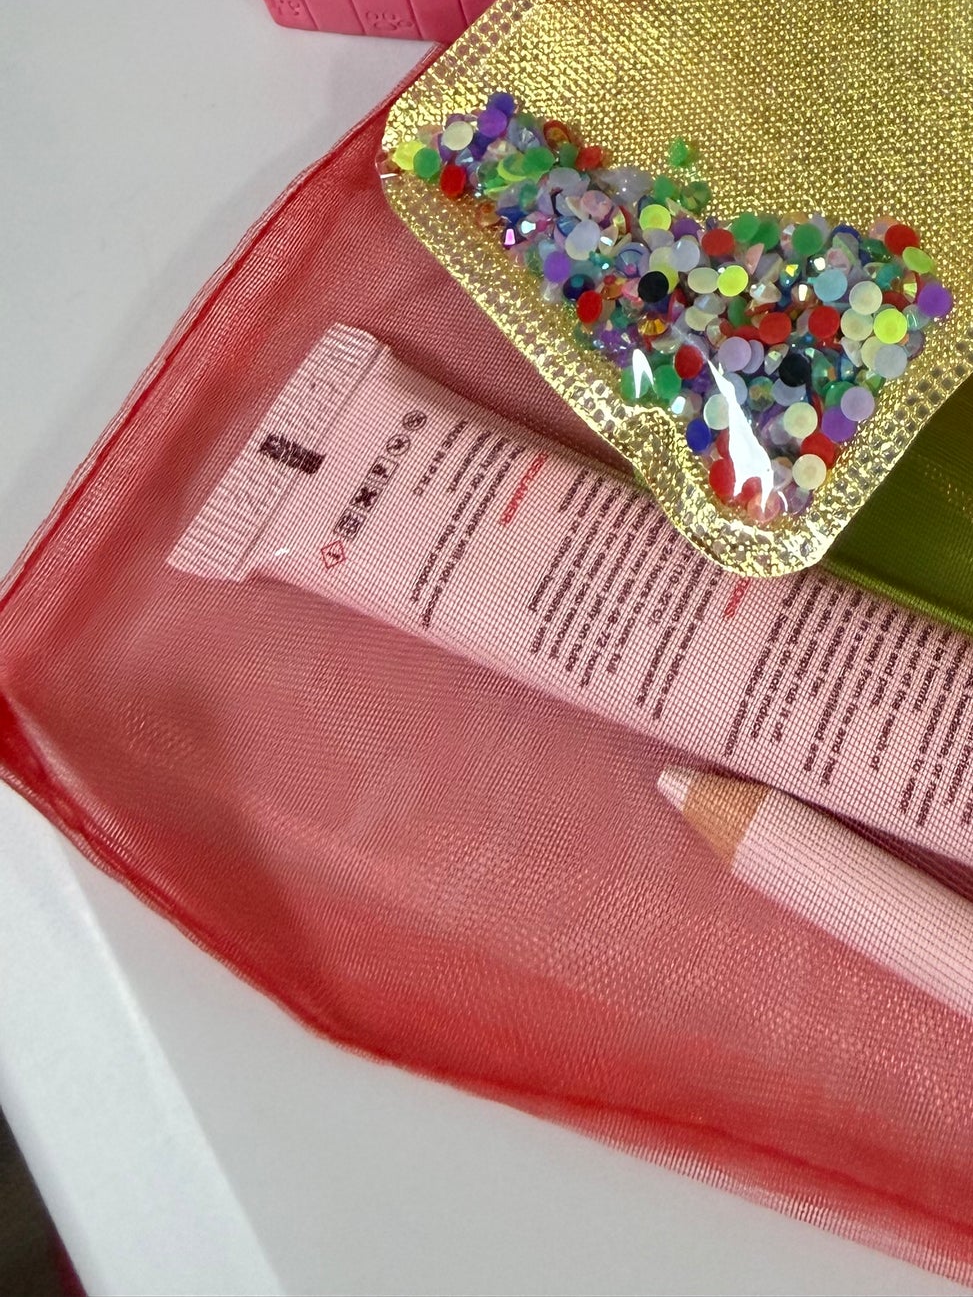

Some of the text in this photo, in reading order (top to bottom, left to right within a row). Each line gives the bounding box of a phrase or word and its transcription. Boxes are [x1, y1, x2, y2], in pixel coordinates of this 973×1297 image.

[441, 418, 468, 450] MADE
[468, 471, 487, 490] for
[450, 490, 475, 523] more
[463, 461, 515, 538] manufacturer
[433, 523, 457, 552] than
[450, 538, 470, 561] will
[601, 531, 619, 551] for
[403, 551, 441, 603] product
[438, 561, 458, 584] not
[529, 485, 623, 655] Clean uncured adhesive with
[583, 550, 608, 581] easy
[597, 531, 639, 593] petroleum
[627, 547, 651, 576] may
[570, 580, 593, 606] cap
[614, 576, 636, 605] take
[638, 563, 664, 599] hours
[416, 584, 446, 631] accept
[583, 592, 607, 621] jelly
[692, 588, 715, 621] small
[678, 621, 700, 652] area
[766, 611, 789, 644] Seek
[562, 642, 584, 673] tube
[605, 651, 623, 674] full
[792, 637, 820, 681] simply
[817, 624, 847, 674] exhaust
[862, 633, 887, 666] away
[882, 651, 901, 677] and
[906, 649, 923, 671] out
[660, 652, 686, 696] before
[744, 645, 774, 698] medical
[767, 668, 785, 692] not
[849, 666, 872, 700] from
[784, 682, 802, 706] rub
[890, 688, 907, 712] the
[747, 693, 775, 739] induce
[839, 701, 857, 726] fire
[915, 692, 949, 756] exposure
[829, 726, 848, 755] and
[874, 712, 898, 754] reach
[895, 774, 919, 815] vapor
